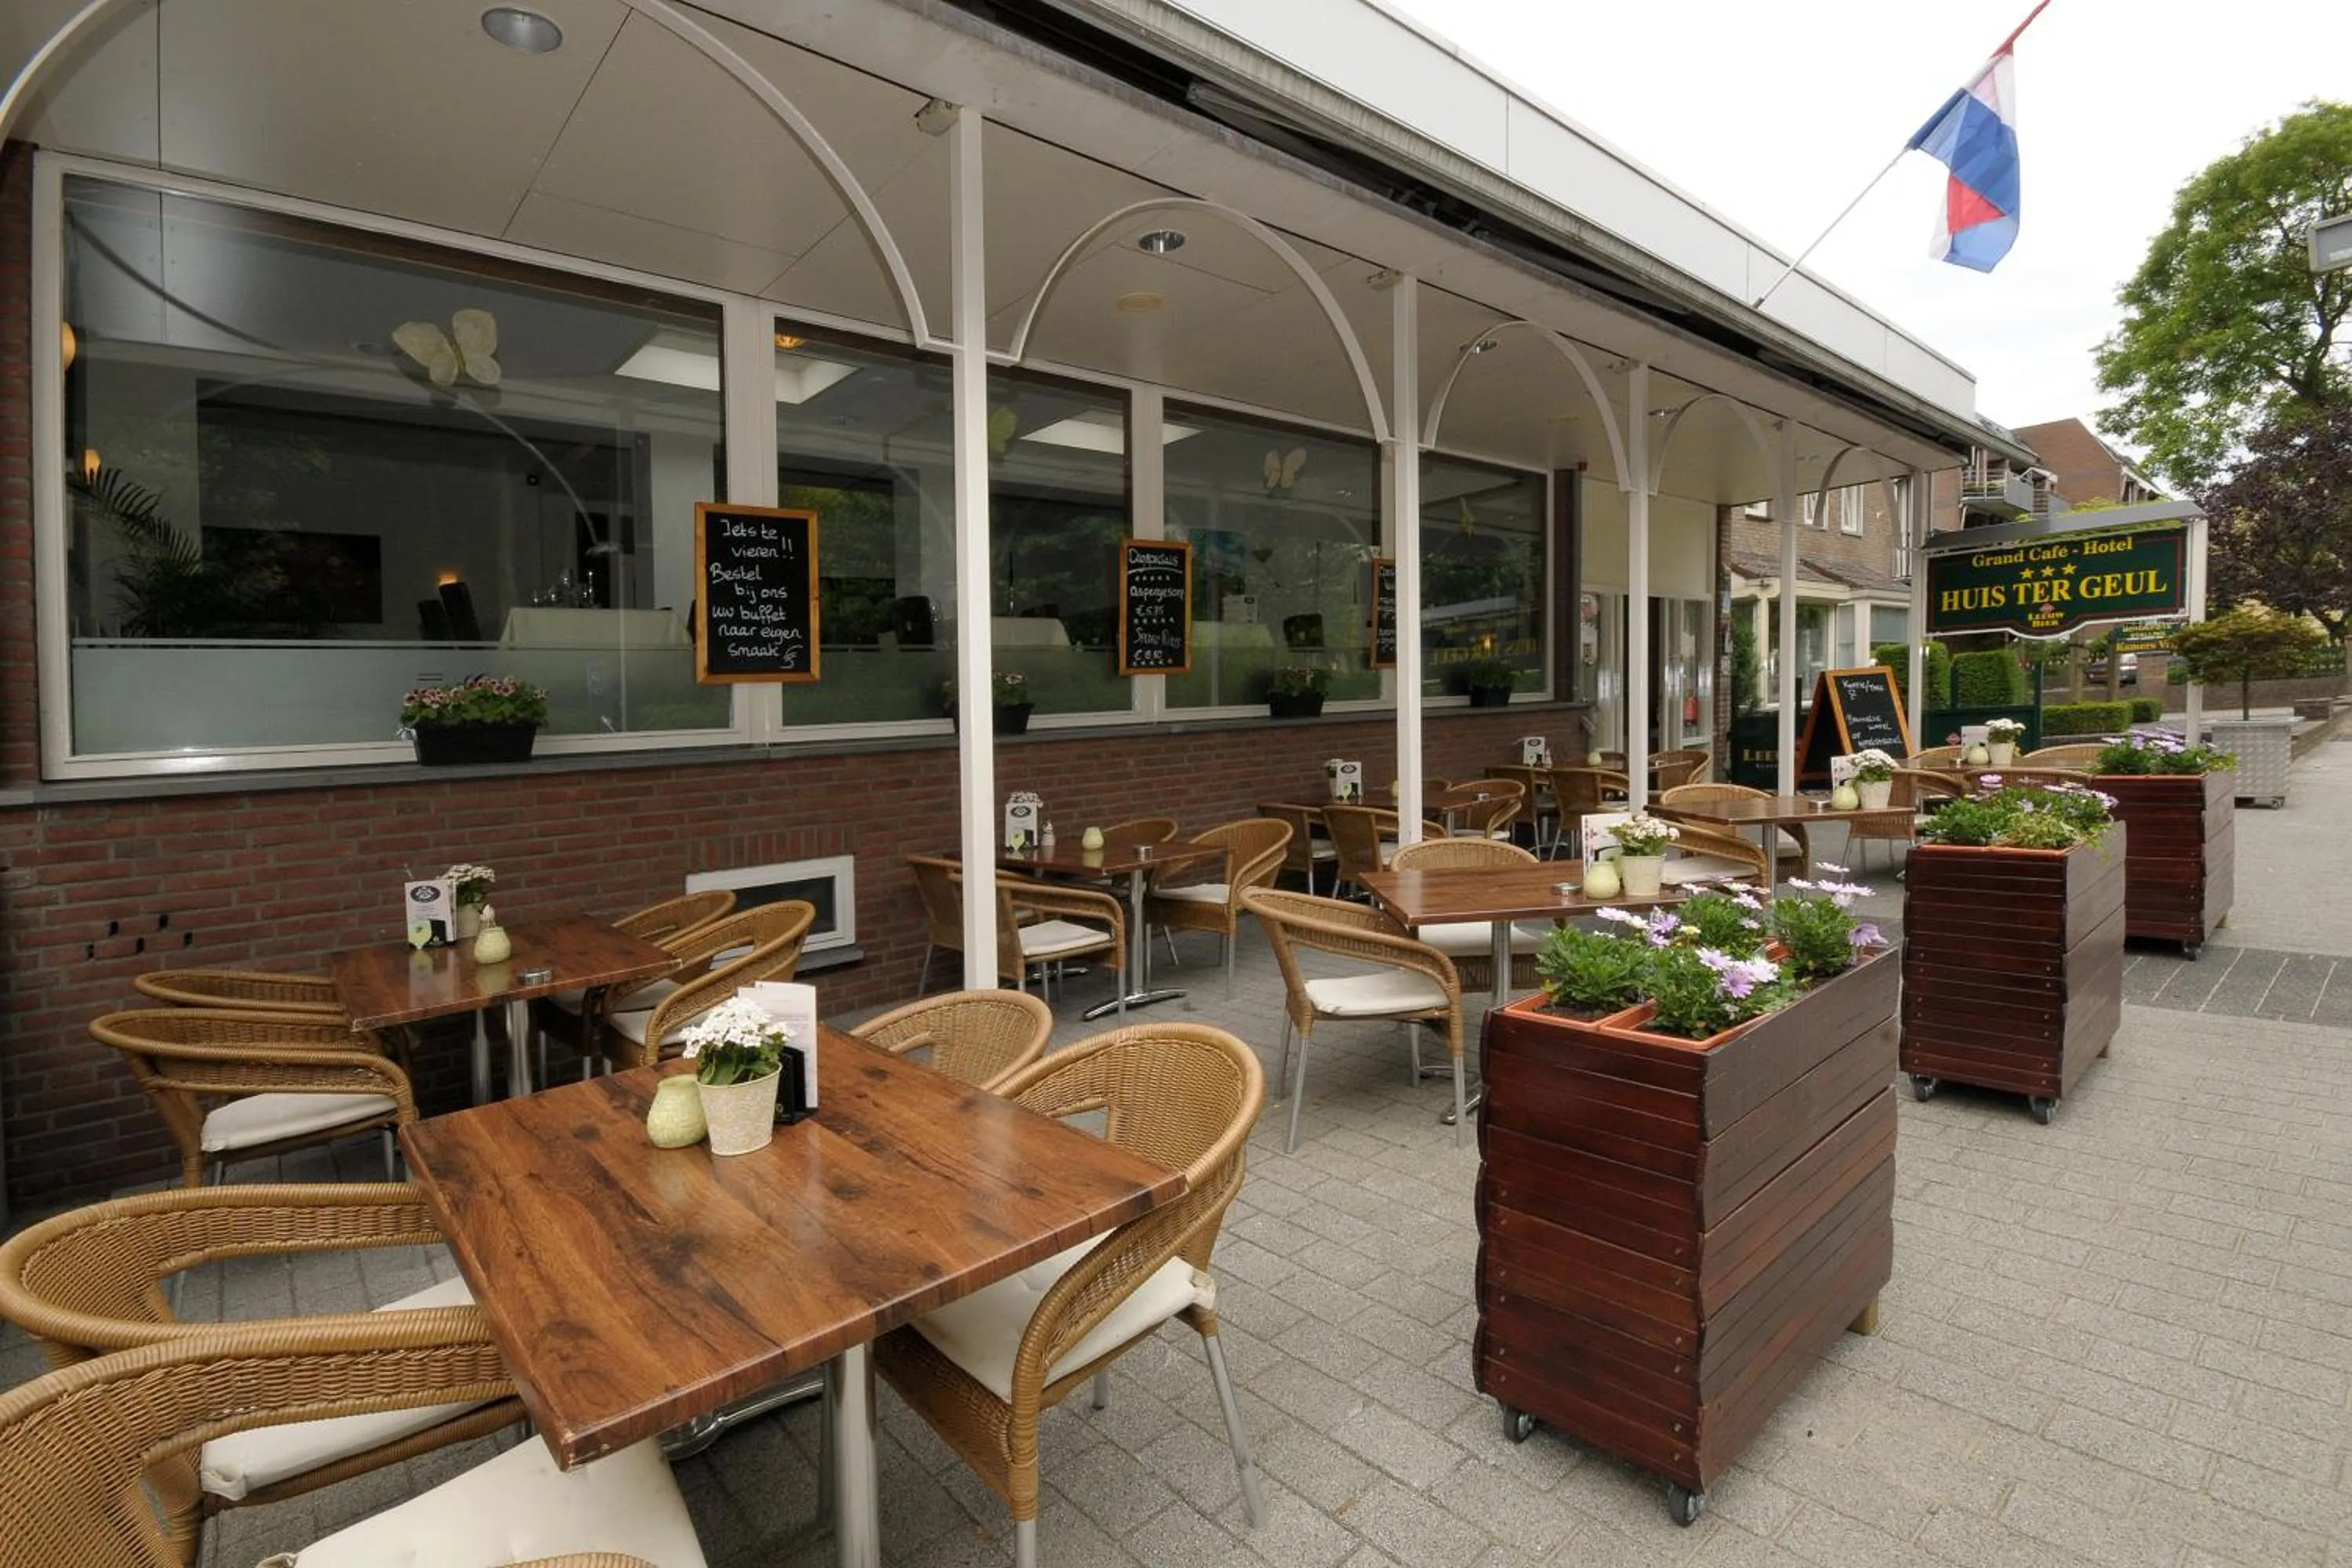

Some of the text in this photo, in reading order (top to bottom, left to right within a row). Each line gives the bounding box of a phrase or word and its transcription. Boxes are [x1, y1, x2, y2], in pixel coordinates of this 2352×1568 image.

[760, 523, 779, 539] te
[1972, 550, 2025, 567] Grand
[2028, 545, 2068, 561] Café
[2082, 536, 2133, 555] Hotel
[710, 562, 763, 583] Bestel
[734, 583, 788, 604] bij ons
[1941, 570, 2168, 612] HUIS TER GEUL
[740, 604, 787, 625] buffet
[718, 625, 802, 645] naar eigen
